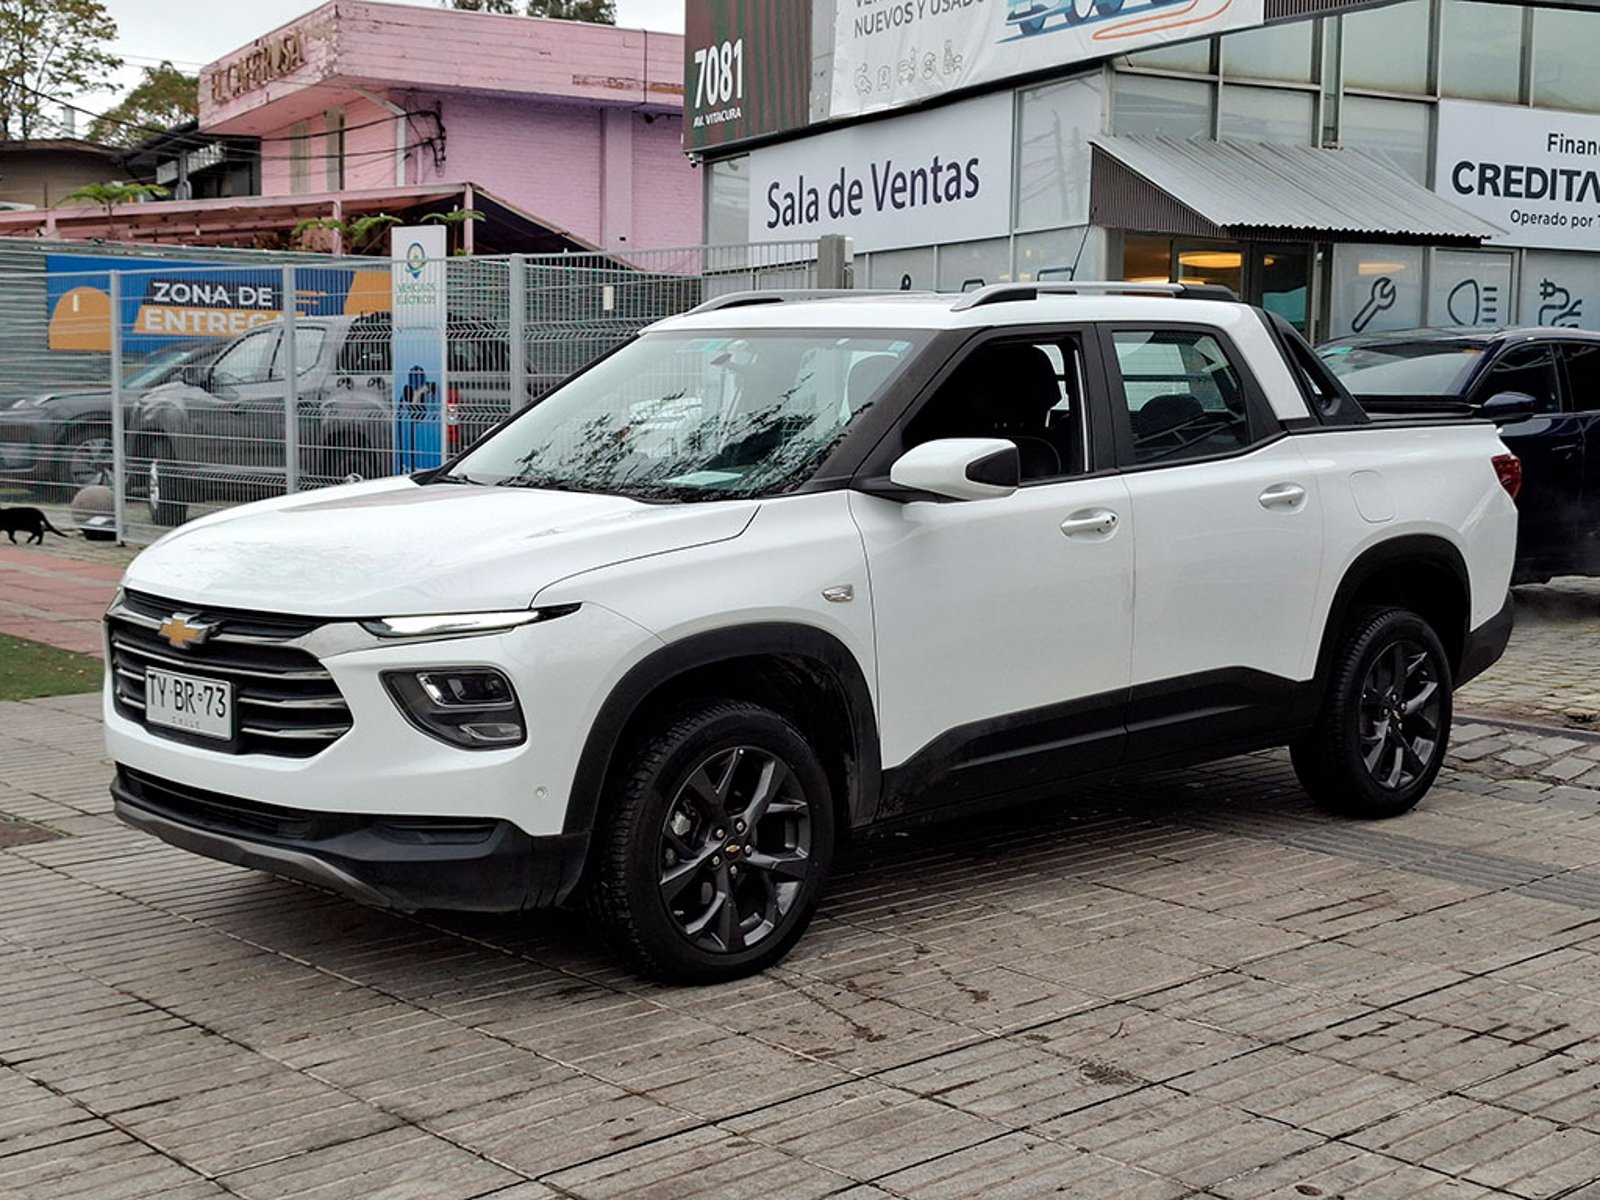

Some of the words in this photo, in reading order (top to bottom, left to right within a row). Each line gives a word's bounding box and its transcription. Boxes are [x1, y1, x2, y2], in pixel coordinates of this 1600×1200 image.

[854, 2, 913, 38] NUEVOS
[916, 0, 926, 20] Y
[694, 38, 743, 109] 7081
[705, 107, 742, 125] VITACURA
[1547, 132, 1600, 155] Finan
[766, 175, 819, 229] Sala
[828, 166, 863, 219] de
[870, 155, 980, 212] Ventas
[1510, 209, 1567, 226] Operado
[1571, 216, 1593, 229] por
[152, 282, 230, 306] ZONA
[238, 287, 273, 307] DE
[144, 309, 286, 335] ENTREG
